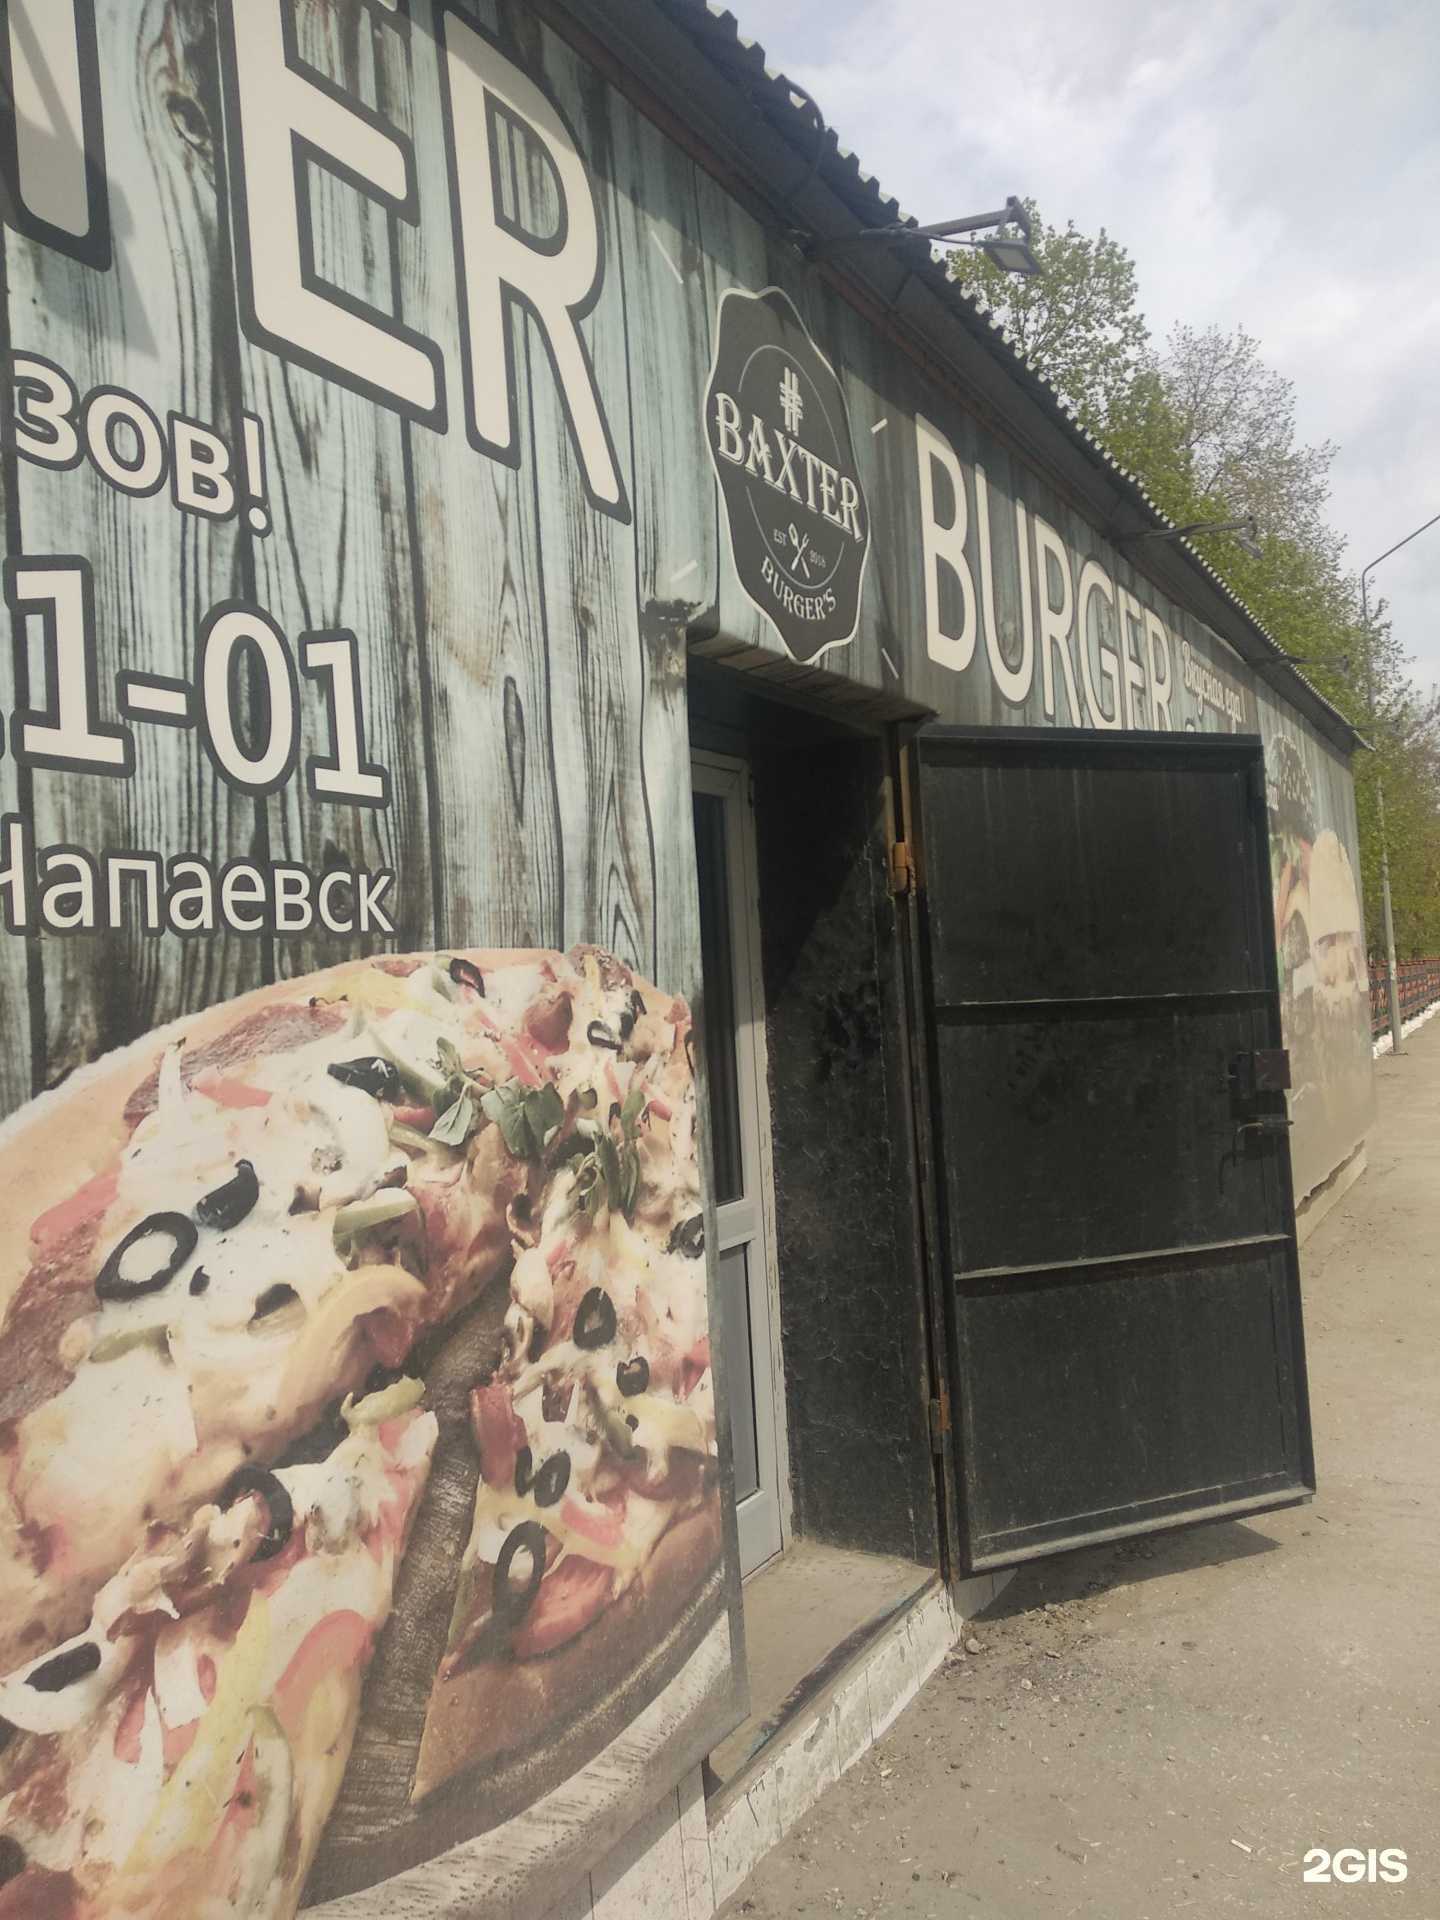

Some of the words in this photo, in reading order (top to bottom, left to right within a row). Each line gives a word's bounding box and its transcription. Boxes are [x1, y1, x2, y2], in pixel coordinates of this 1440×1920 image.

[715, 392, 864, 543] BAXTER
[761, 555, 836, 620] BURGER'S
[914, 412, 1173, 731] BURGER
[16, 569, 384, 798] 1-01
